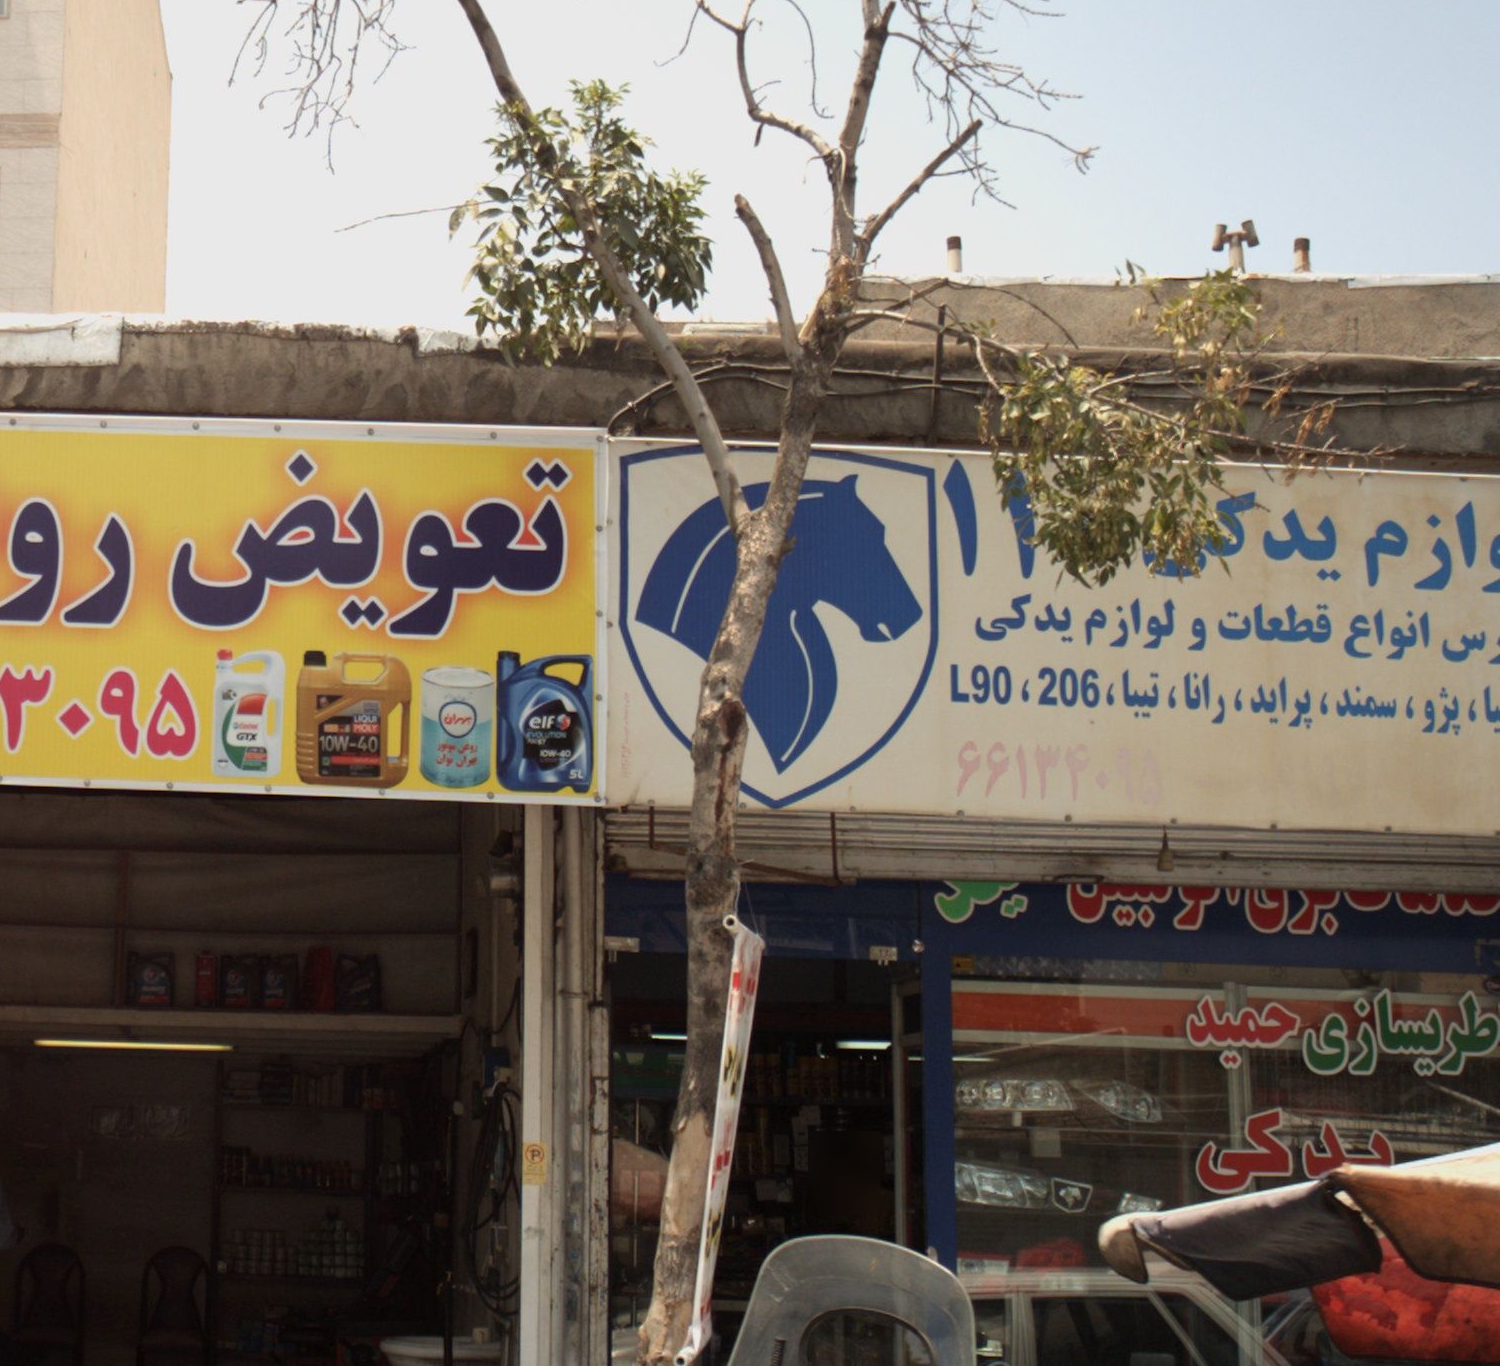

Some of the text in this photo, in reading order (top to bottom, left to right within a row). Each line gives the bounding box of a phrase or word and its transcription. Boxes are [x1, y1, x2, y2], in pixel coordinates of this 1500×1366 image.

[170, 451, 573, 639] تعویض
[975, 593, 1072, 643] یدکی
[1085, 598, 1176, 650] لوازم
[1187, 617, 1207, 652] و
[1217, 603, 1332, 644] قطعات
[1343, 608, 1430, 660] انواع
[949, 663, 1013, 706] L90
[236, 732, 258, 742] GTX
[353, 724, 379, 733] MOLY
[354, 715, 378, 724] LIQUI
[528, 715, 556, 730] elf
[320, 735, 379, 753] 10W-40
[540, 749, 573, 758] 10W-40
[1187, 994, 1301, 1070] حمید
